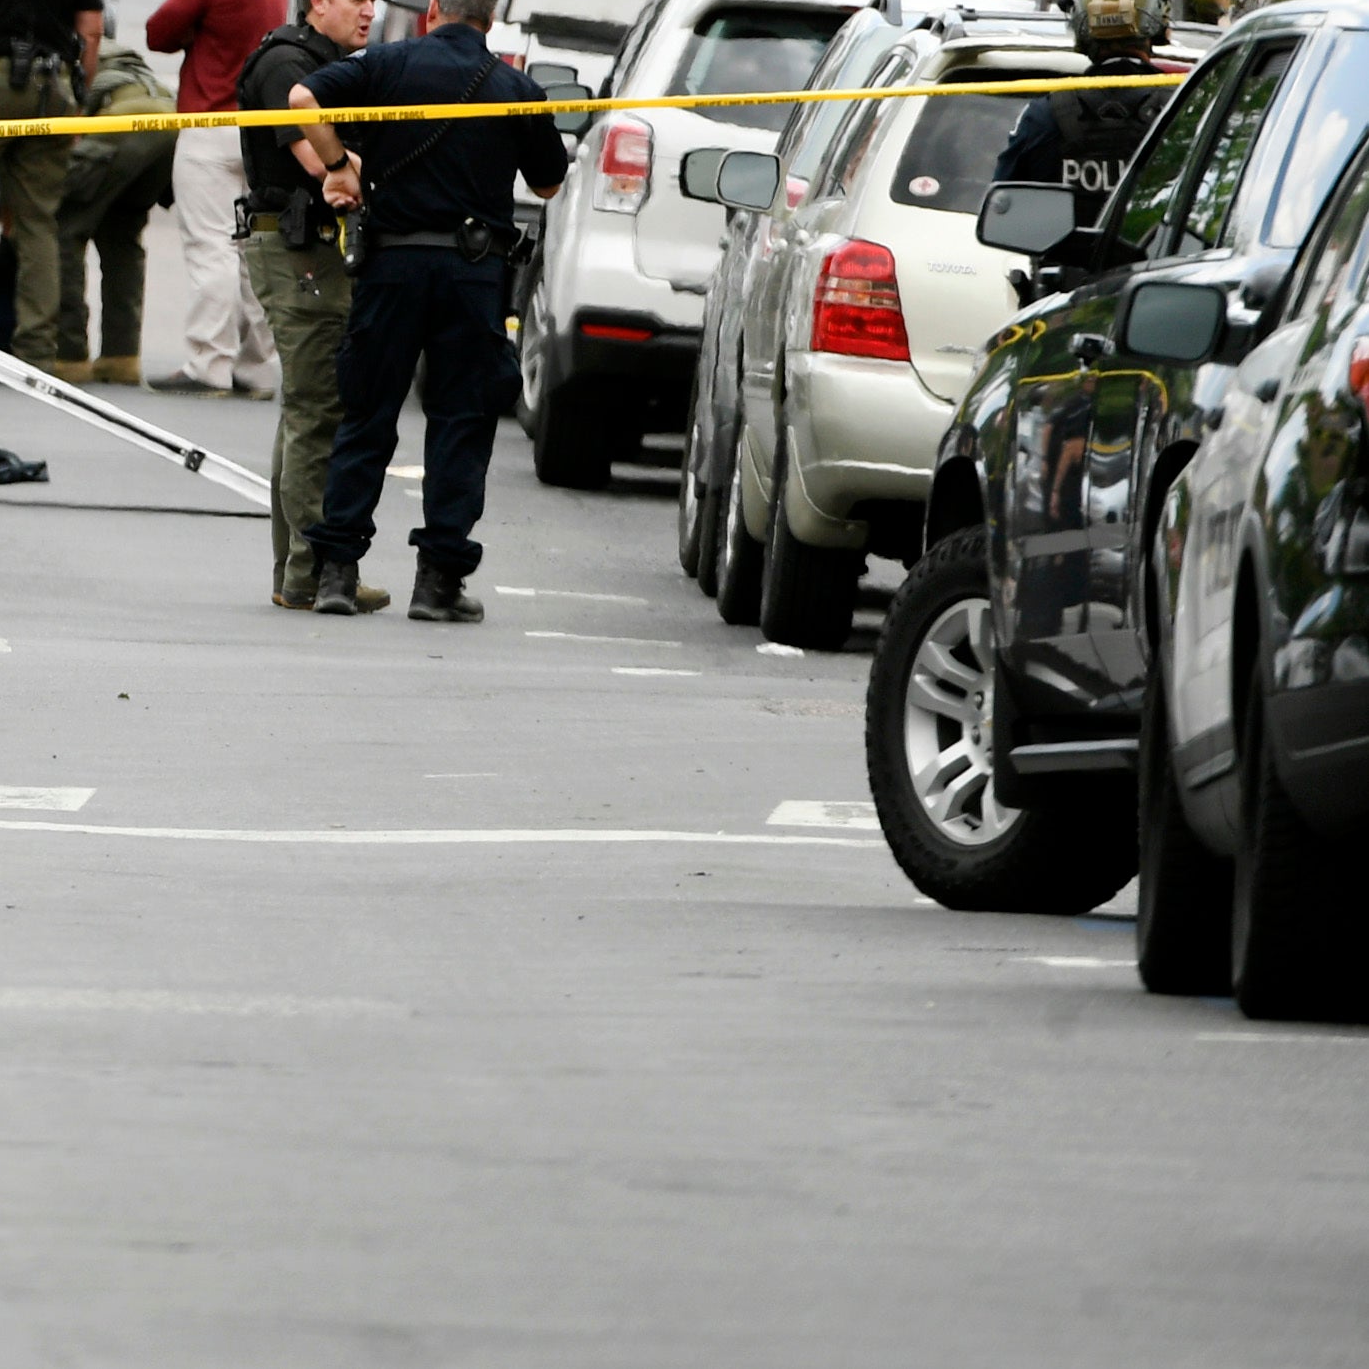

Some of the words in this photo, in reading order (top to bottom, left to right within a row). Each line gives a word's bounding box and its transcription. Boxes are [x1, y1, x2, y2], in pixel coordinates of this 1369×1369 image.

[132, 119, 159, 131] POLICE
[161, 118, 179, 130] LINE
[181, 118, 192, 129] DO
[194, 117, 209, 128] NOT
[212, 116, 238, 127] CROSS
[319, 113, 346, 124] POLICE
[349, 112, 367, 122] LINE
[399, 110, 425, 120] CROSS
[7, 125, 23, 136] NOT
[25, 123, 52, 135] CROSS
[1062, 157, 1126, 192] POLI
[927, 261, 977, 276] TOYOTA
